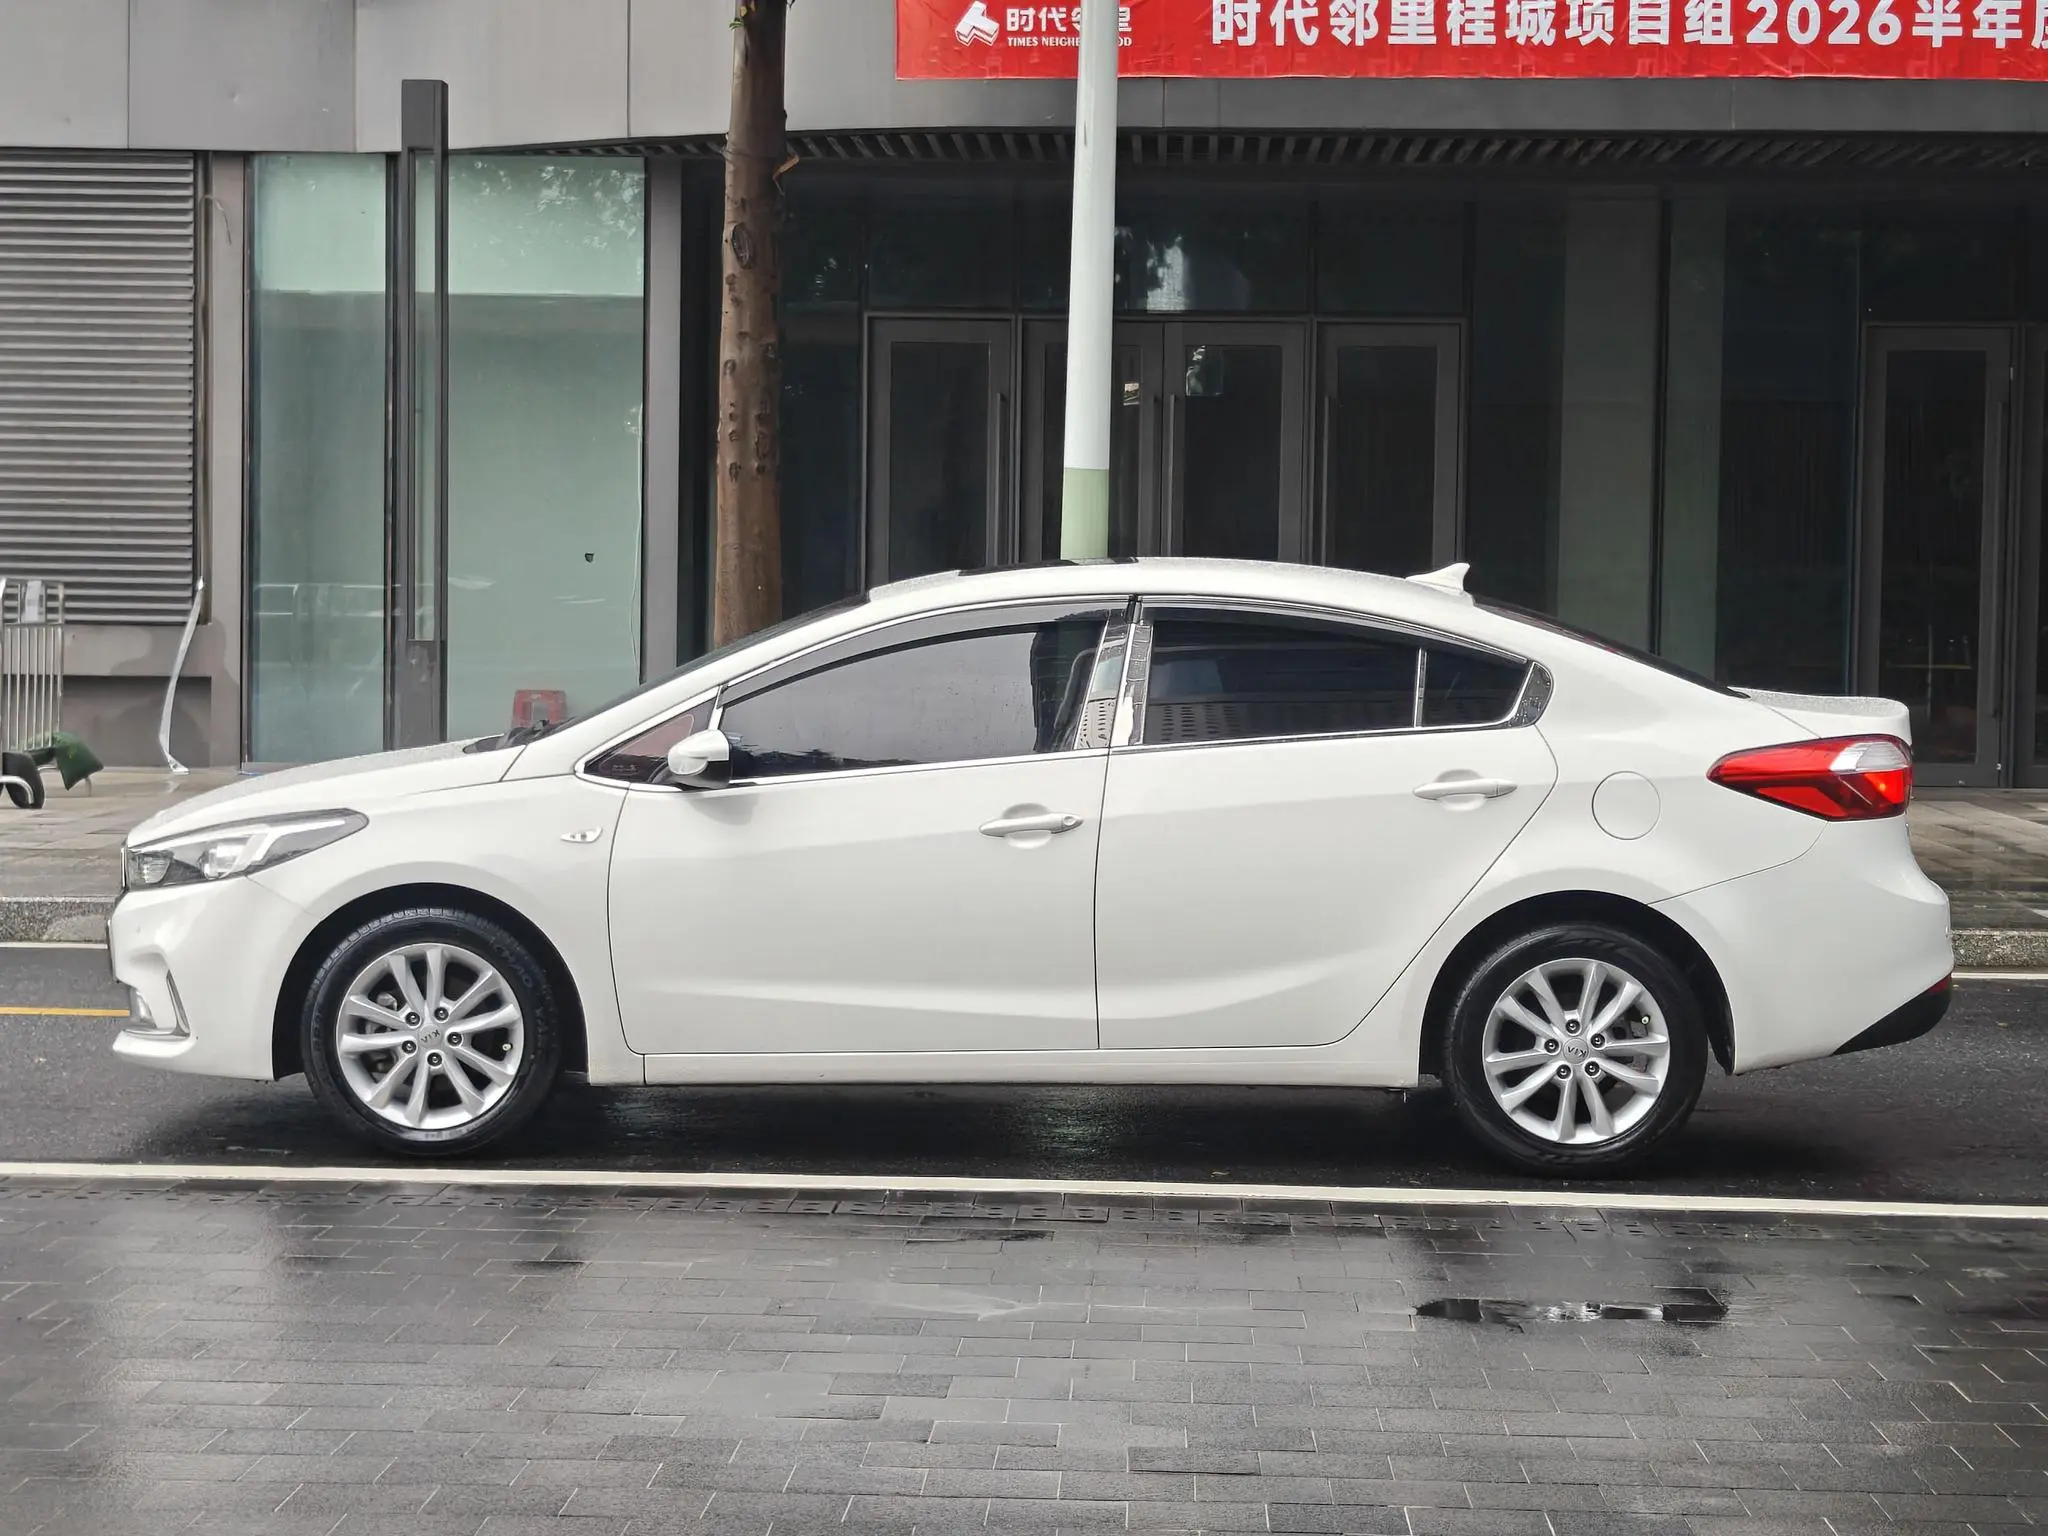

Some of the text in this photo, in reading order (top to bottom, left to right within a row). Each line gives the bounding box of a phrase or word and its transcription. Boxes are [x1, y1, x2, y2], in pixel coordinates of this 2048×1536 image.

[1007, 36, 1133, 47] TIMES NEIGHOD
[421, 1029, 441, 1044] KIA
[1567, 1046, 1587, 1058] KIA
